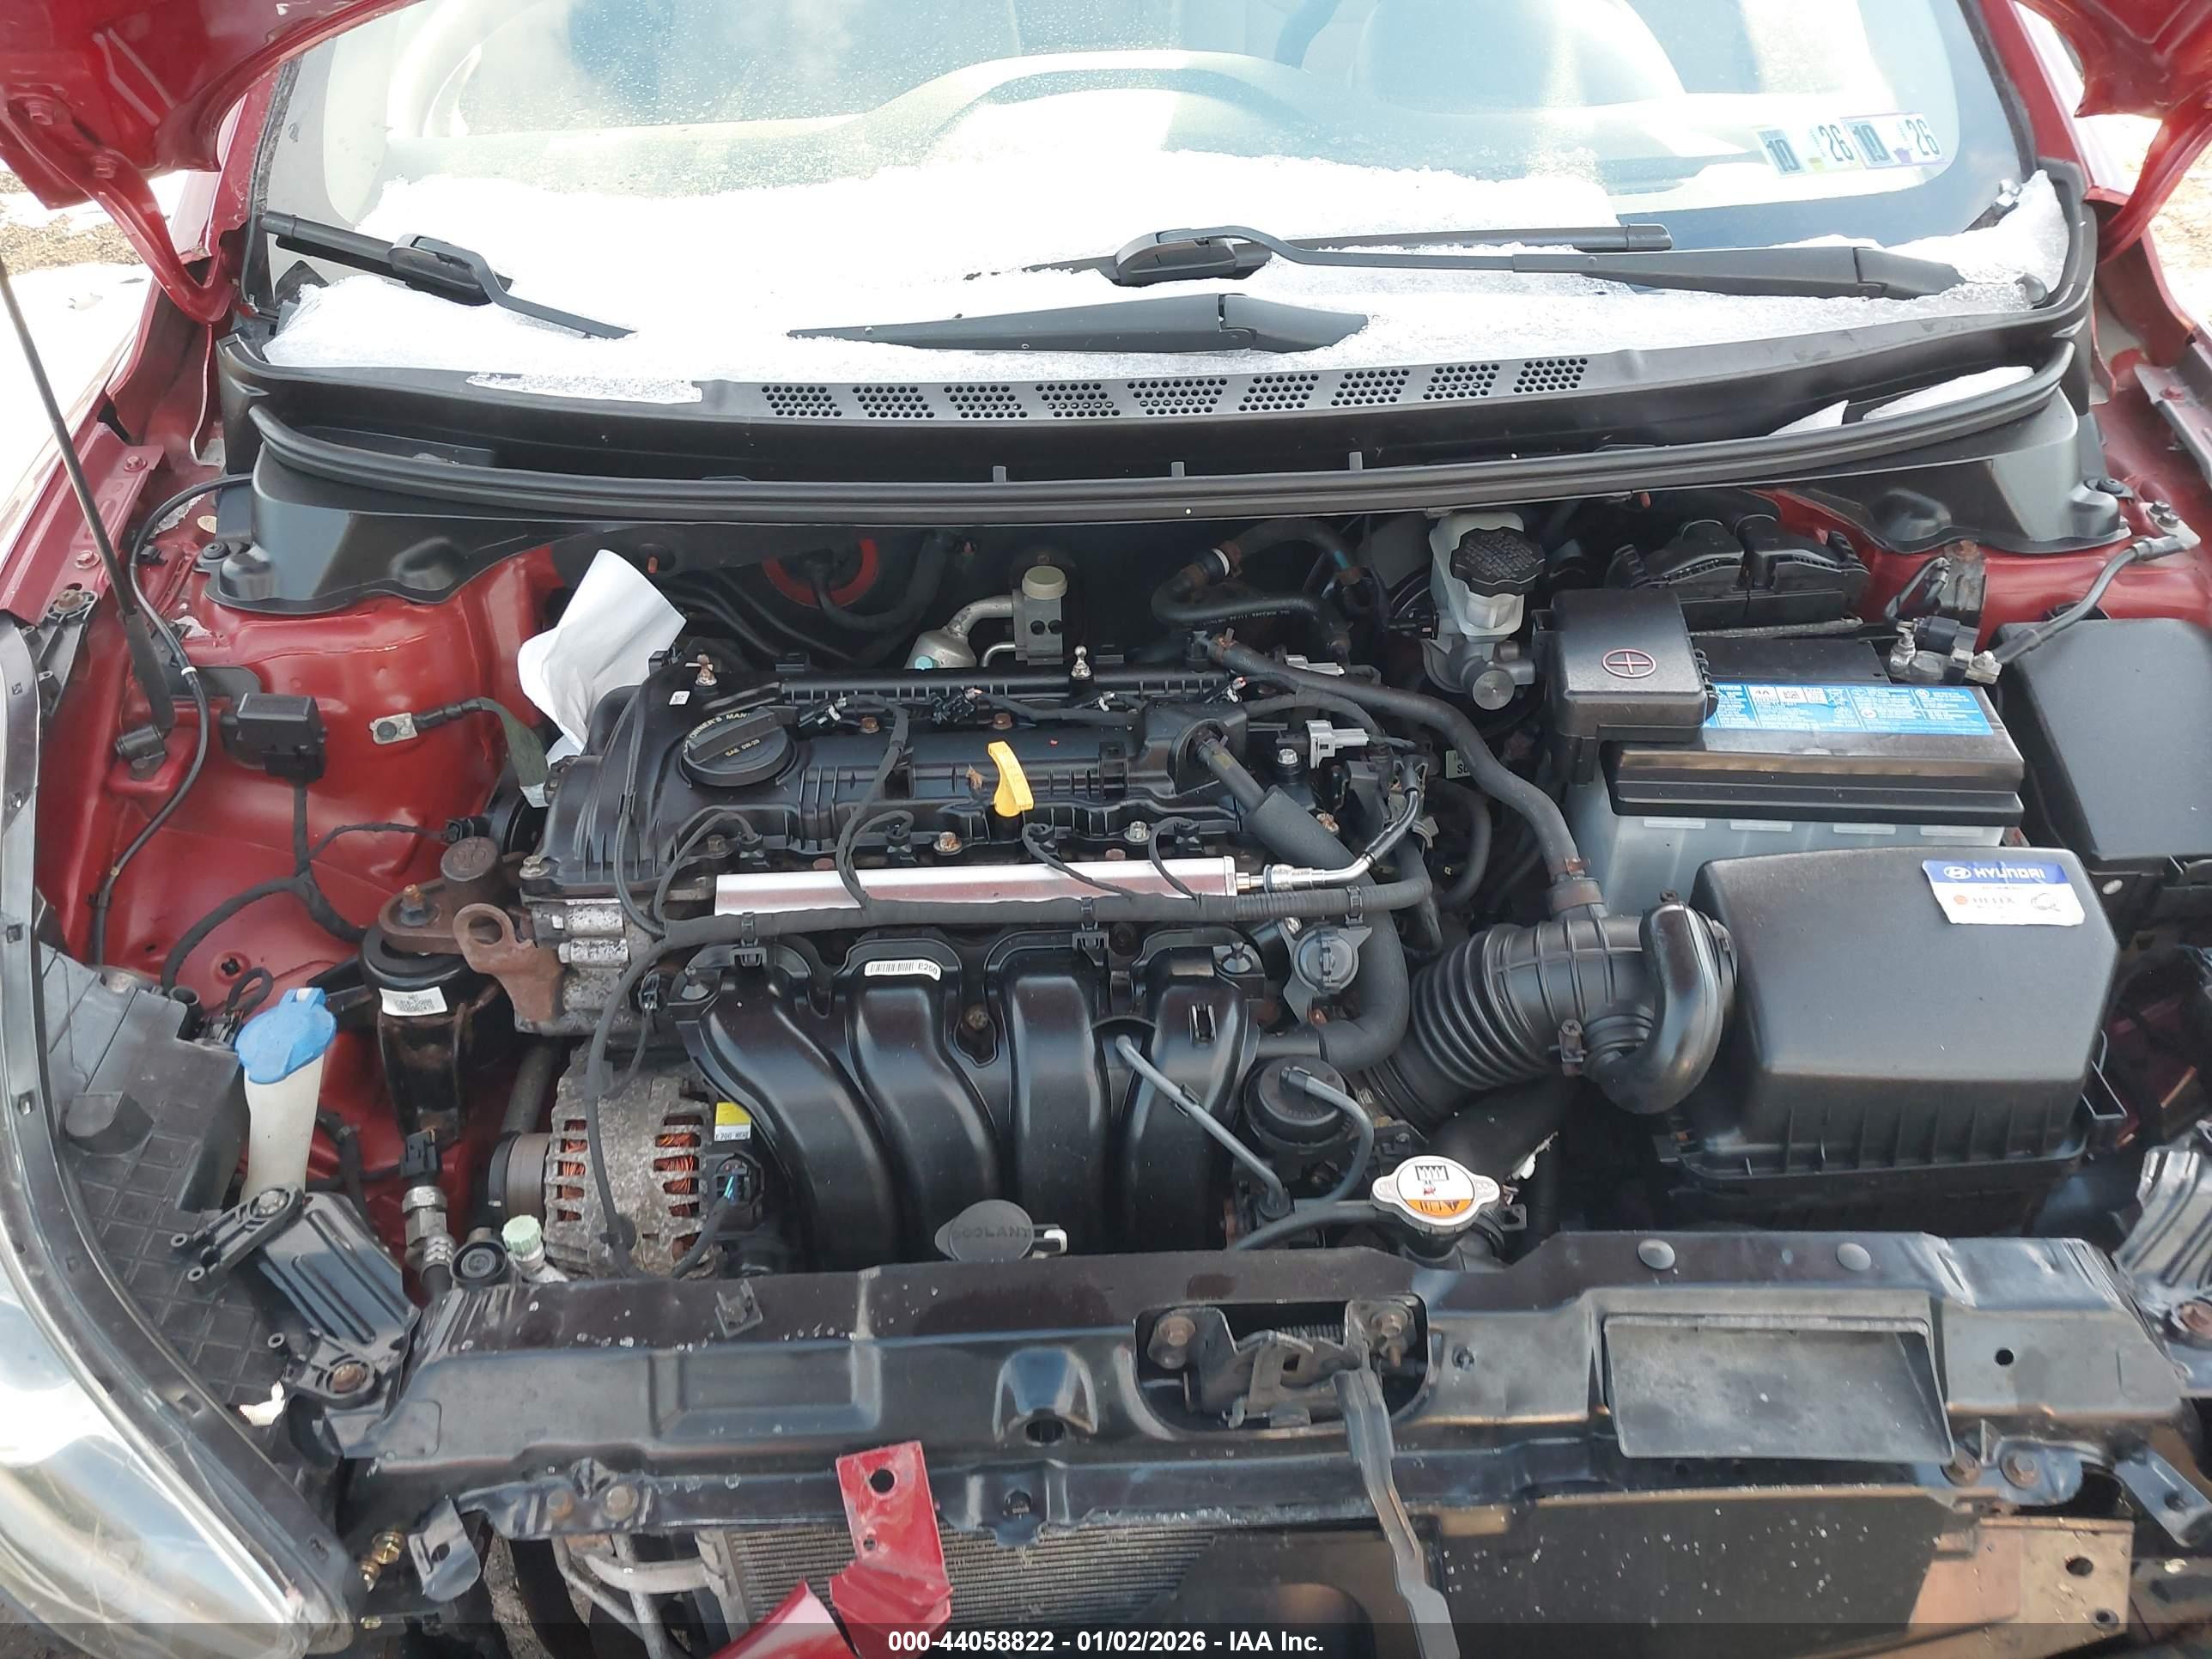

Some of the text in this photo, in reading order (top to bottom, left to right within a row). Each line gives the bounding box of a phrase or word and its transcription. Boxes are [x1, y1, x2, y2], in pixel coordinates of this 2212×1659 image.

[1819, 125, 1854, 161] 26
[1906, 119, 1940, 155] 26
[1973, 867, 2046, 879] HYUNDAI
[952, 1225, 1031, 1237] COOLANT
